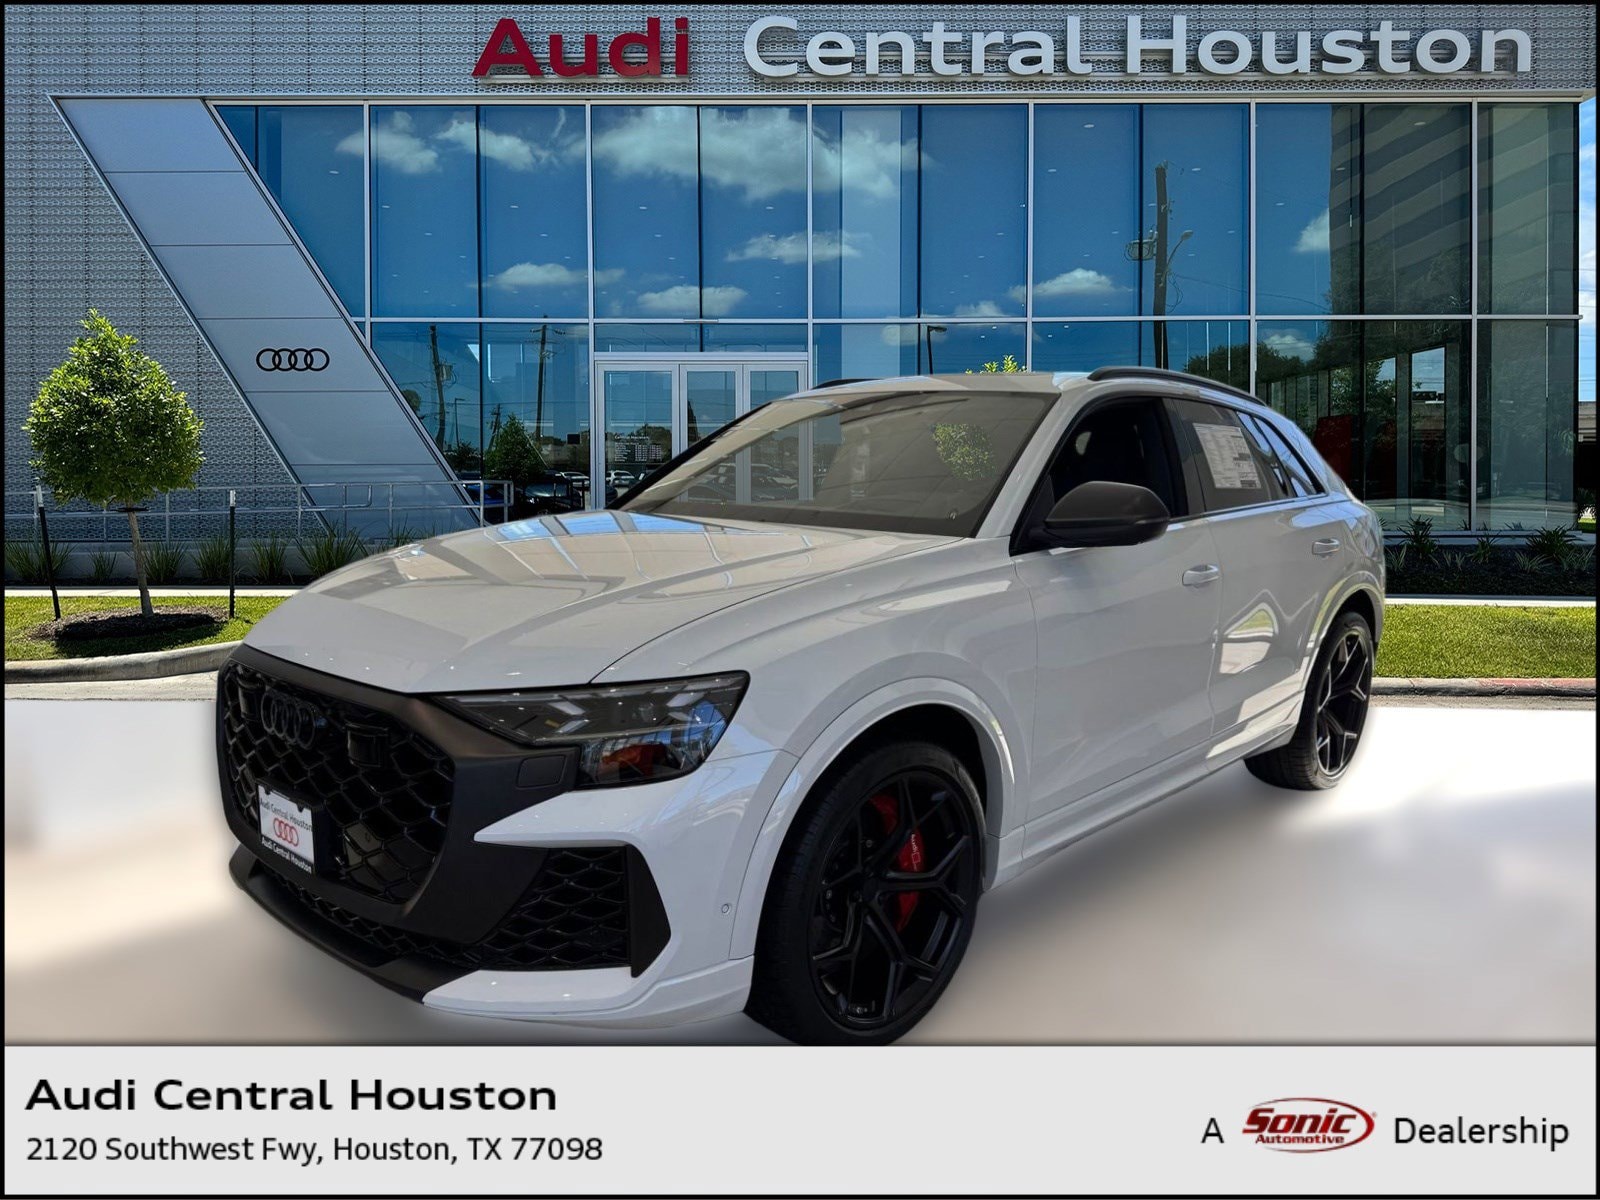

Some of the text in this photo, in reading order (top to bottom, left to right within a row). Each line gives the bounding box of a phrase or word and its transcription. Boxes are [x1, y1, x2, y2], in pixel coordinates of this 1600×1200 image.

[471, 14, 1532, 78] Audi Central Houston
[271, 803, 289, 820] Central
[289, 813, 313, 832] Houston
[273, 843, 291, 860] Central
[290, 854, 312, 874] Houston
